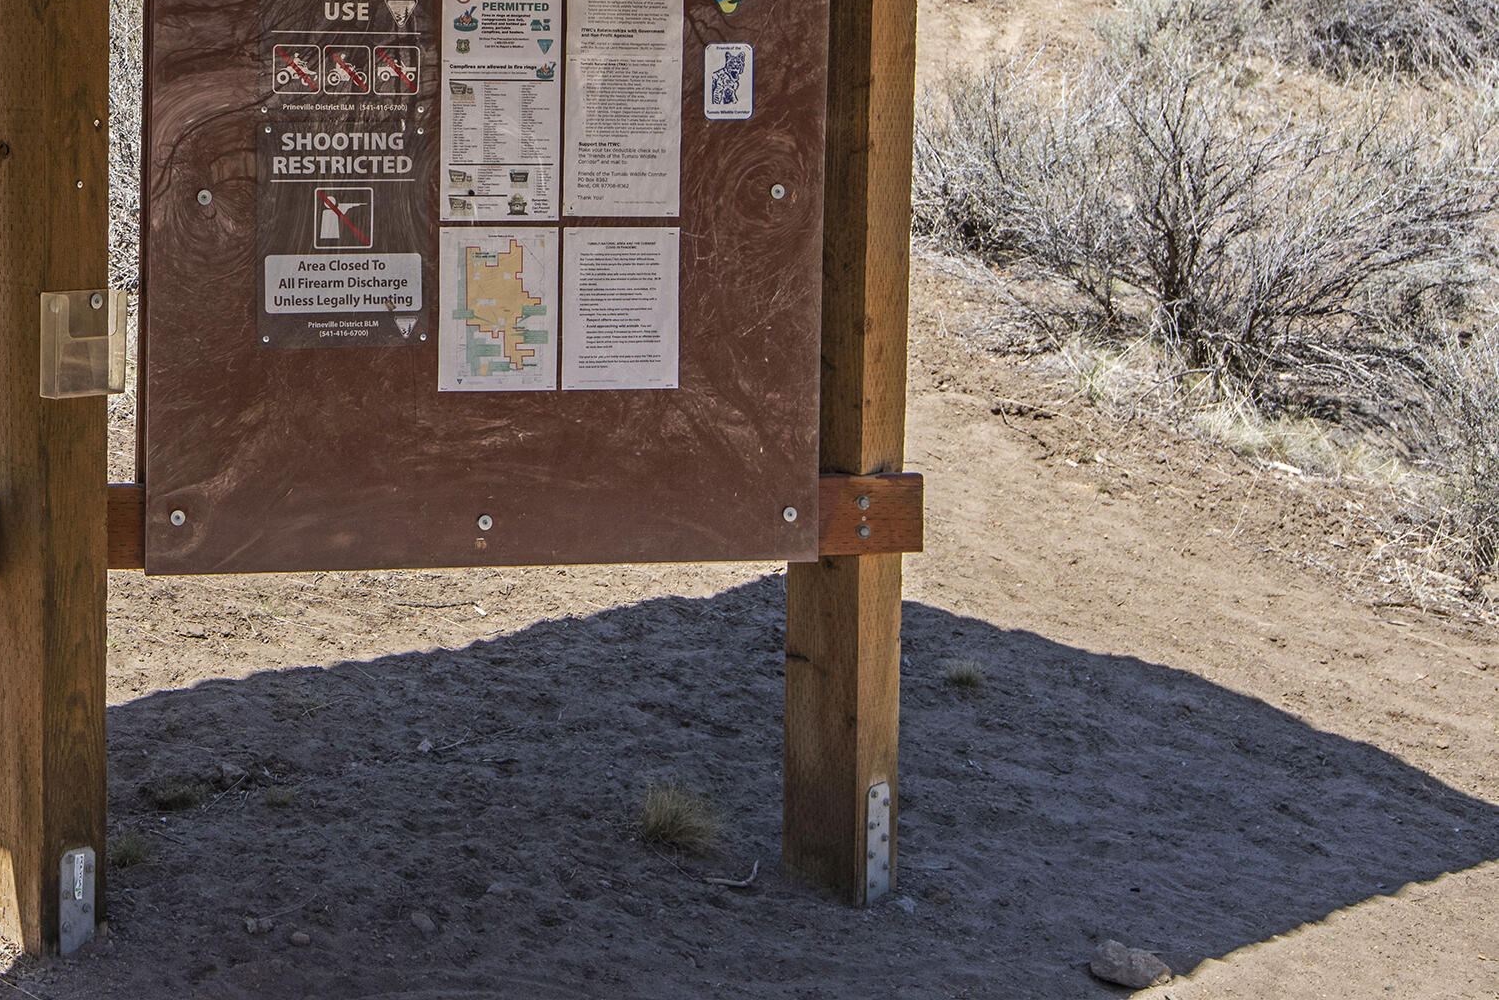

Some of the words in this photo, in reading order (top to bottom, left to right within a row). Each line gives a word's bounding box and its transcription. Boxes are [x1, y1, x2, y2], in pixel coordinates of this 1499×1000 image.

[324, 2, 369, 21] USE
[482, 2, 550, 12] PERMITTED
[282, 103, 314, 112] Prineville
[314, 103, 339, 111] District
[281, 132, 404, 151] SHOOTING
[272, 156, 413, 175] RESTRICTED
[297, 260, 326, 272] Area
[328, 260, 369, 271] Closed
[371, 260, 386, 270] To
[278, 278, 295, 289] All
[297, 277, 345, 289] Firearm
[347, 277, 408, 290] Discharge
[274, 295, 314, 307] Unless
[316, 294, 361, 308] Legally
[362, 293, 413, 306] Hunting
[308, 321, 339, 330] Prineville
[319, 329, 369, 338] (541-416-6700)
